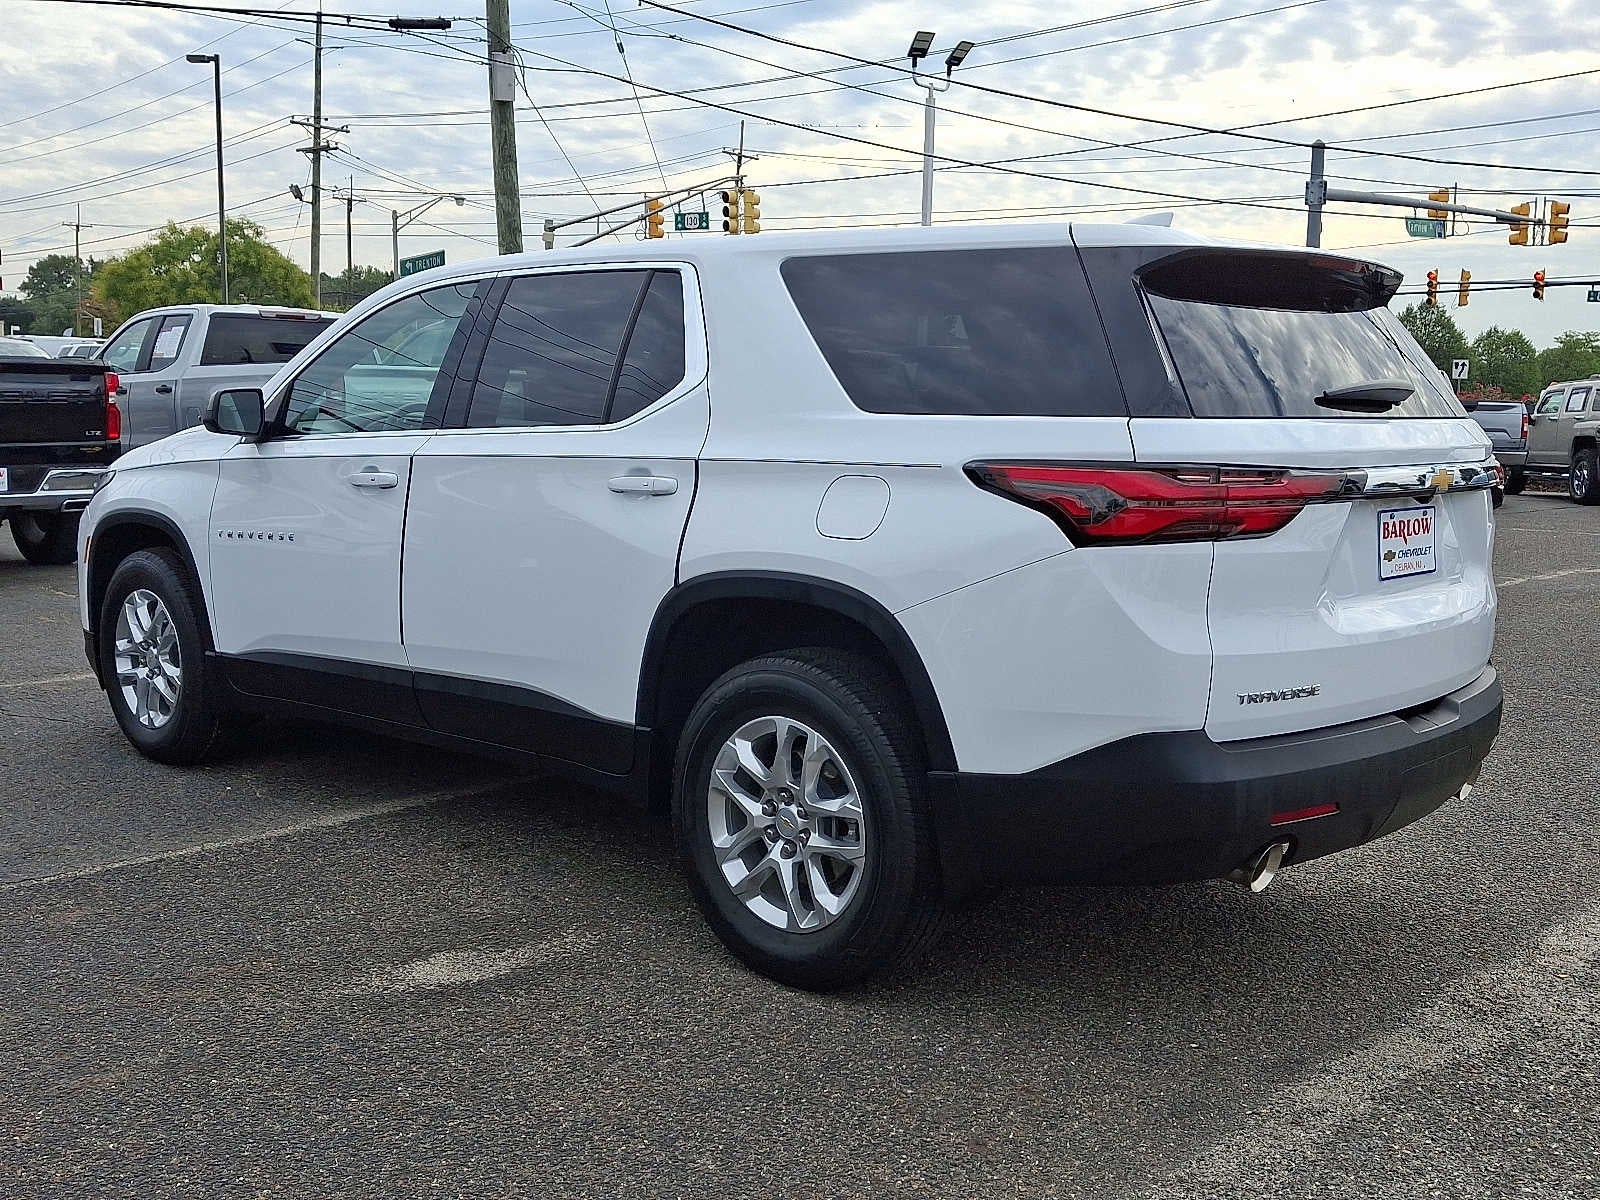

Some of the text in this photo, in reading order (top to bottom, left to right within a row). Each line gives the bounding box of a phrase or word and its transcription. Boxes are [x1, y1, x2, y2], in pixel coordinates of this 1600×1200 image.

[686, 216, 698, 226] 130
[415, 255, 441, 271] TRENTON
[216, 528, 295, 542] TRAVERSE
[1382, 516, 1433, 546] BARLOW
[1397, 545, 1433, 559] CHEVROLET
[1236, 683, 1321, 706] TRAVERSE
